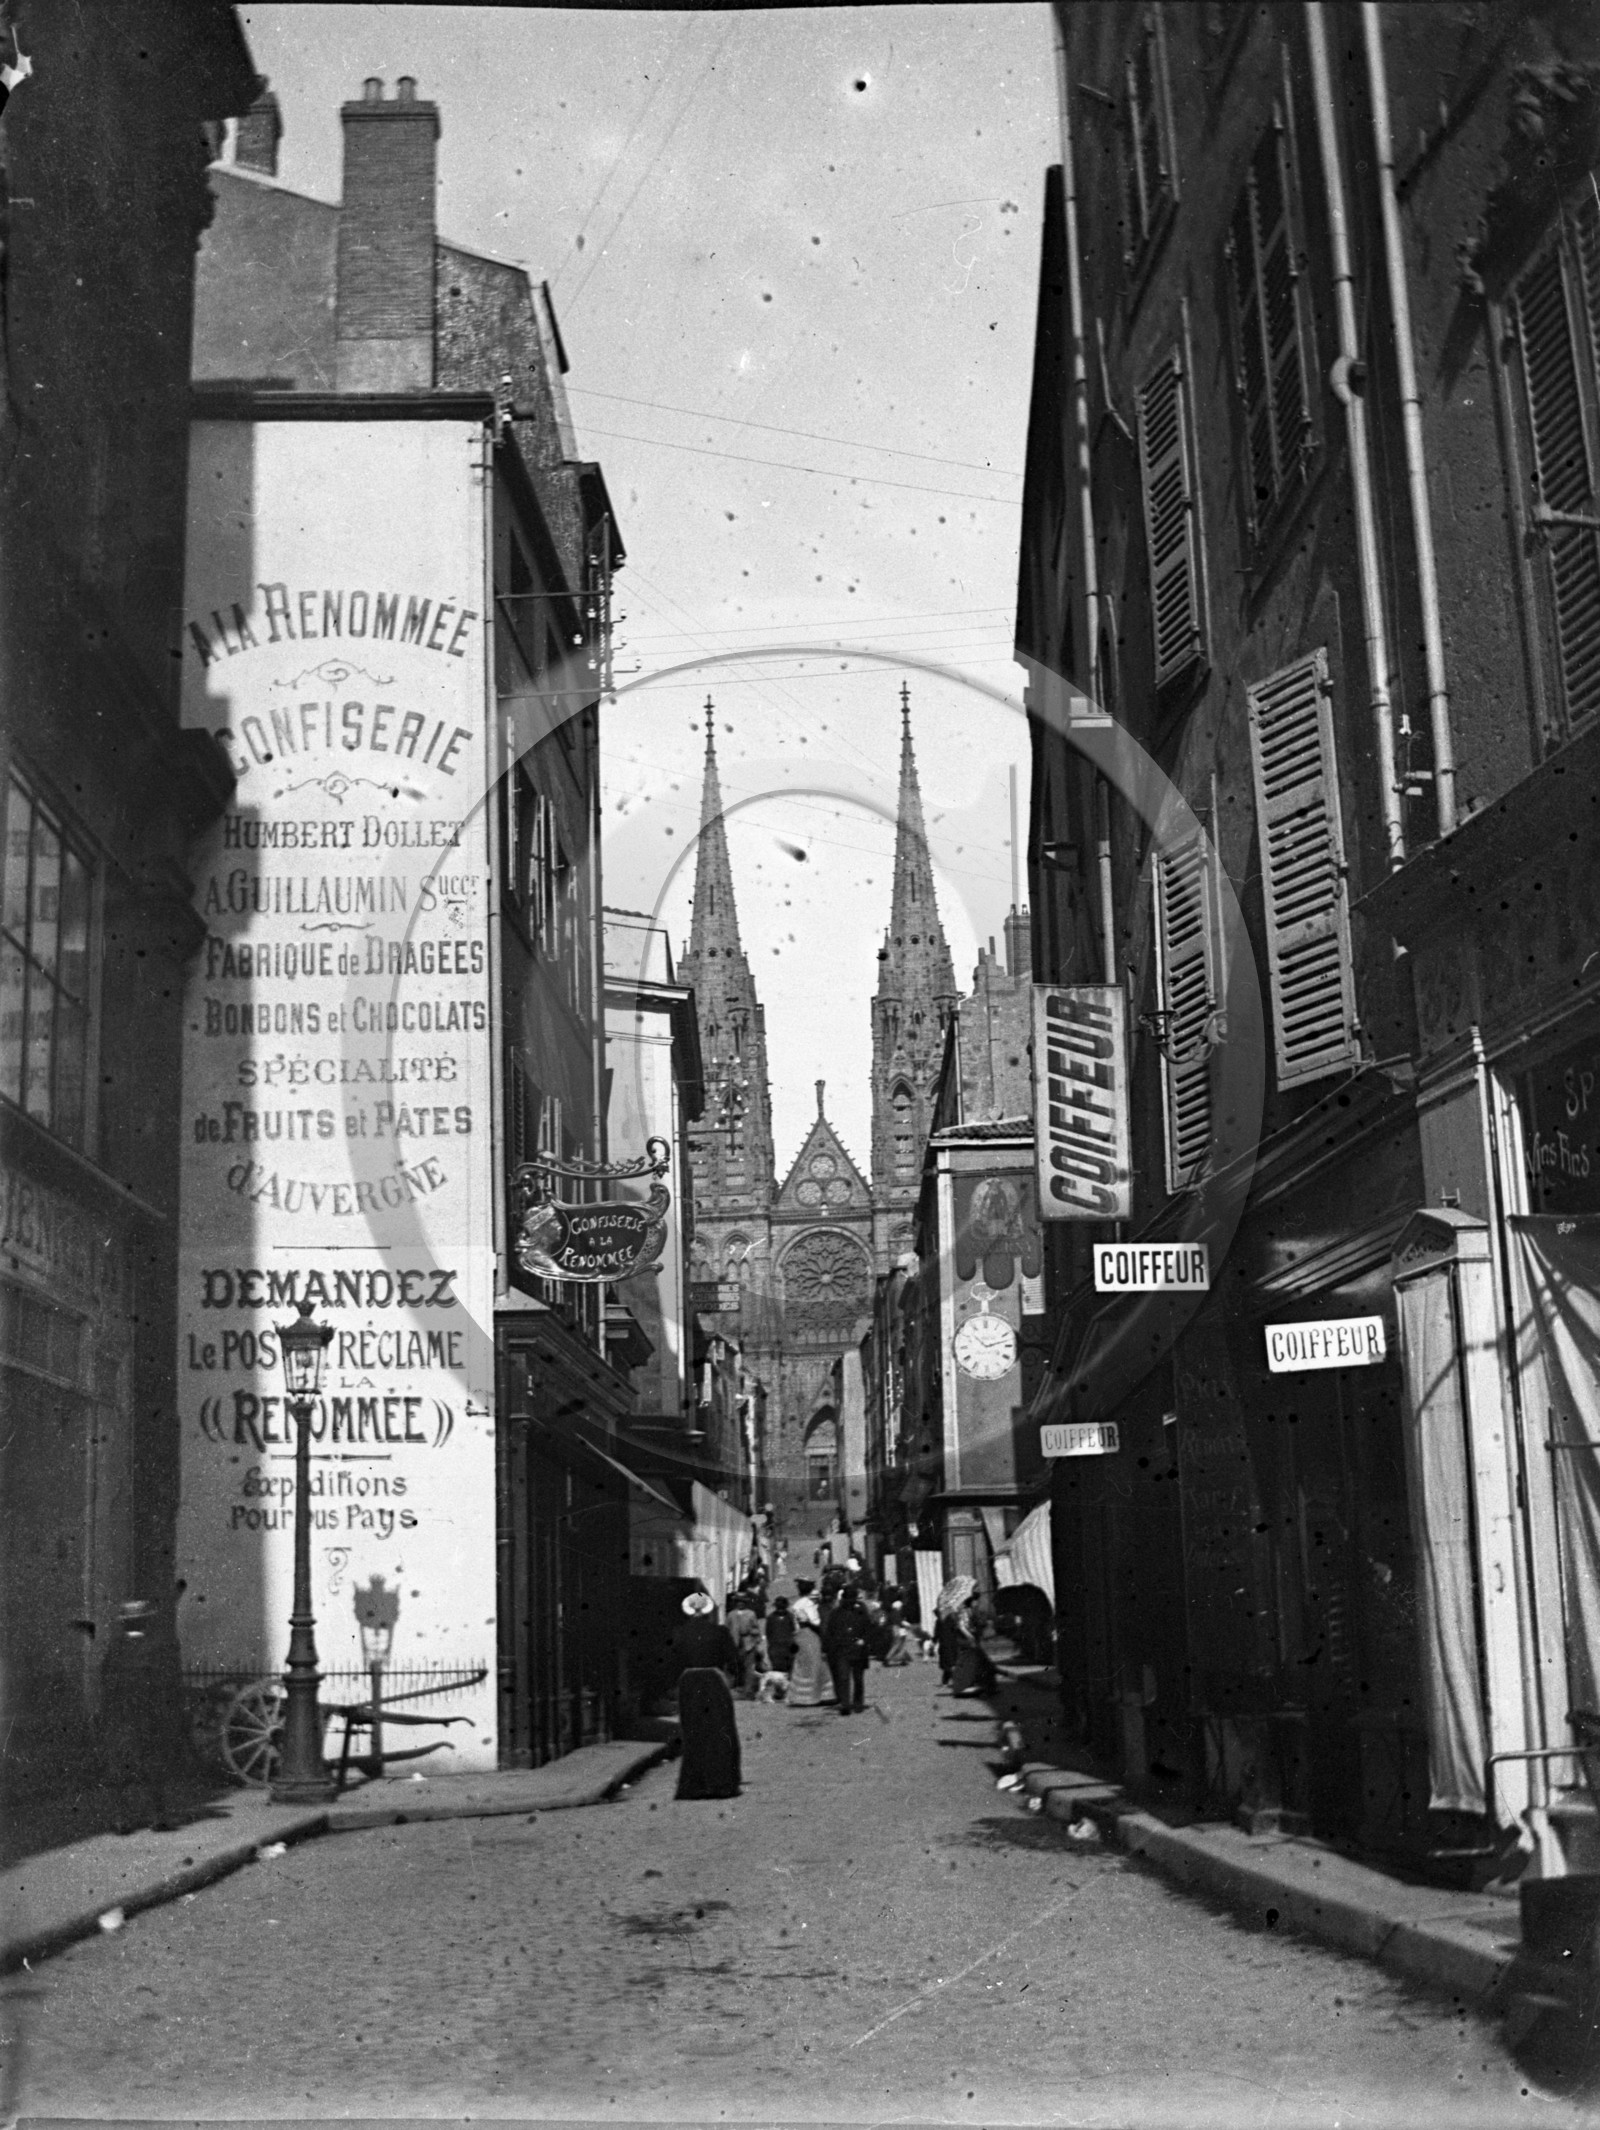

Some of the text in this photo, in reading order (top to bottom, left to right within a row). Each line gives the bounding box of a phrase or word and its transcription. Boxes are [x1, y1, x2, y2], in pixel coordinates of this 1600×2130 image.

[211, 602, 260, 656] LA
[214, 701, 474, 777] CONFISERIE
[224, 812, 465, 849] HUMBERT DOLLET
[338, 942, 360, 976] de
[203, 996, 486, 1038] BONBONS et CHOCOLATS
[238, 1052, 458, 1087] SPÉCIALITÉ
[194, 1098, 473, 1144] de FRUITS et PÂTES
[1046, 994, 1120, 1214] COIFFEUR
[570, 1214, 646, 1235] CONFISERIE
[600, 1236, 613, 1246] LA
[1100, 1250, 1205, 1285] COIFFEUR
[201, 1269, 458, 1309] DEMANDEZ
[338, 1321, 466, 1371] RÉCLAME
[1271, 1324, 1382, 1363] COIFFEUR
[340, 1375, 376, 1389] LA
[1045, 1425, 1117, 1450] COIFFEUR
[243, 1466, 408, 1507] Expditions
[346, 1503, 418, 1540] Pays
